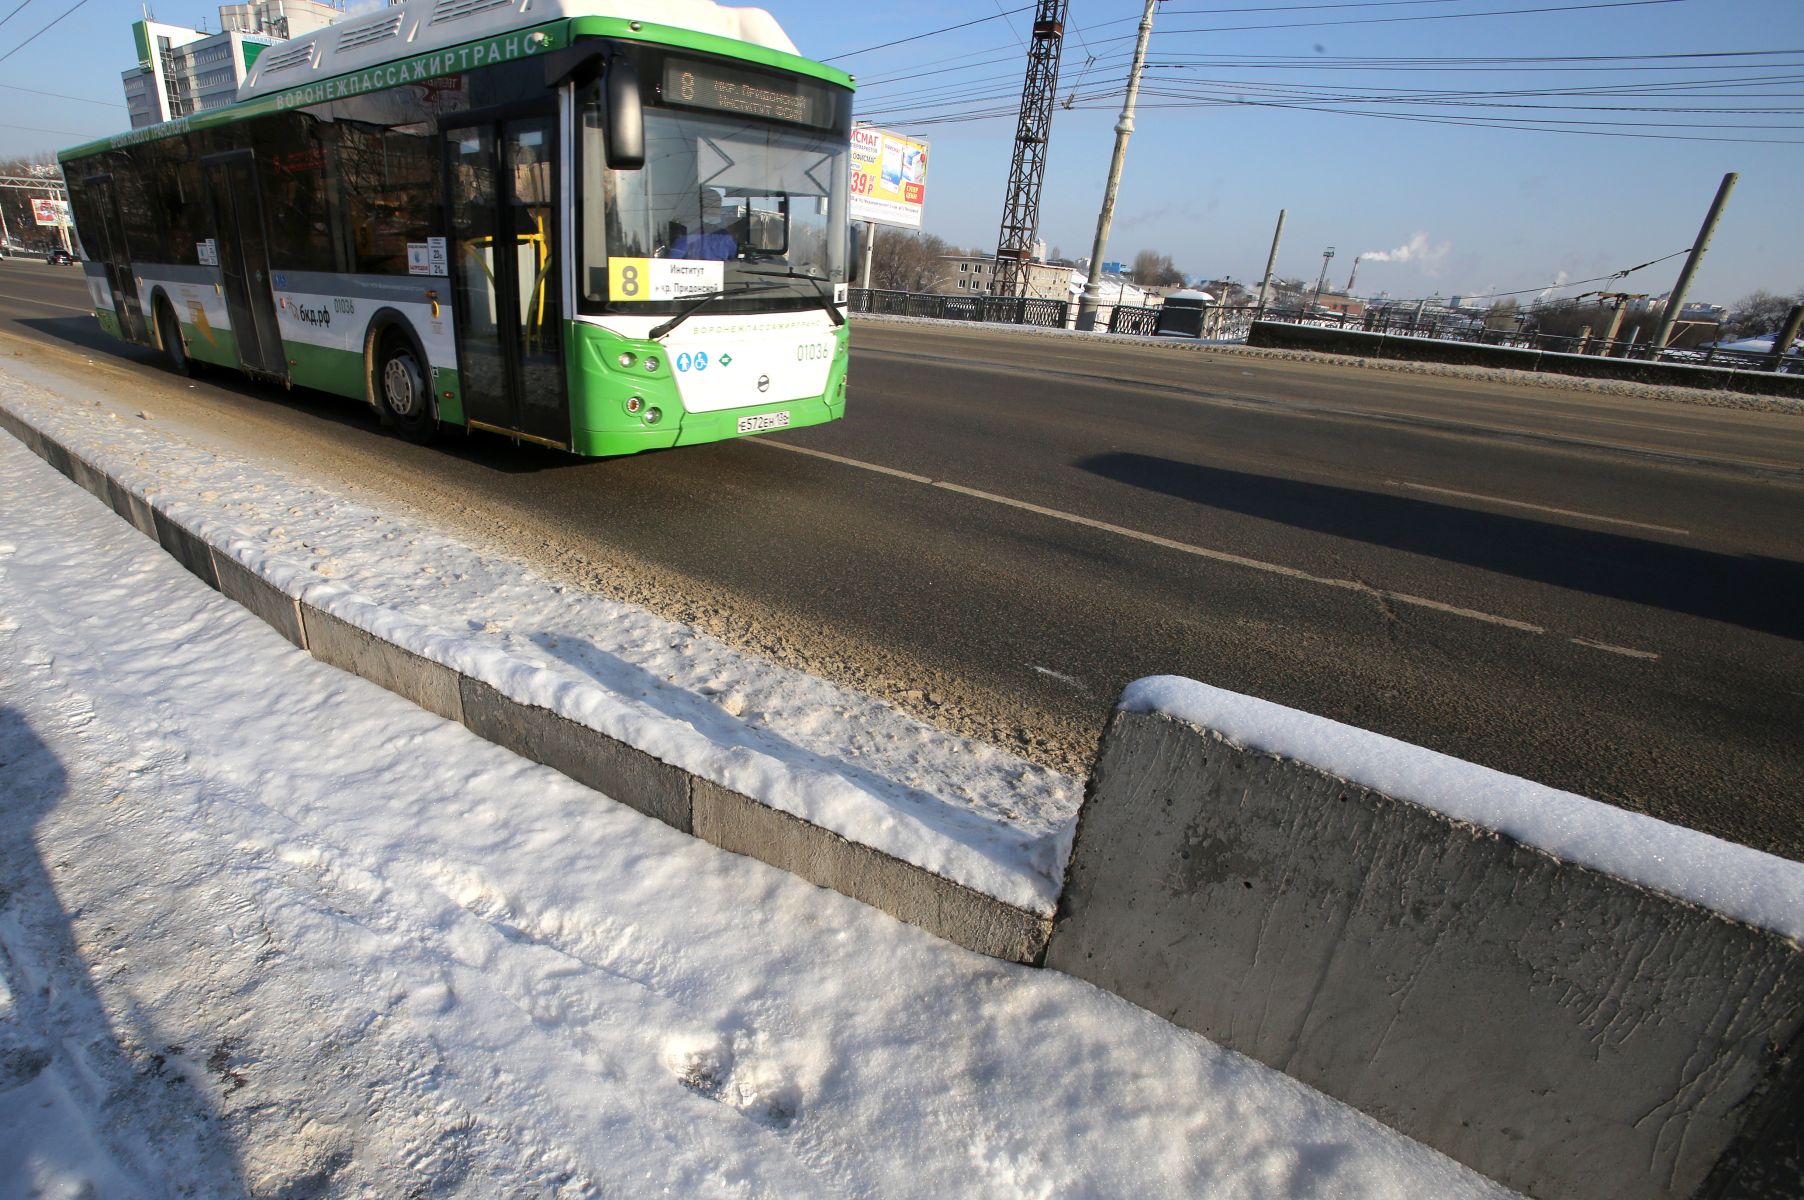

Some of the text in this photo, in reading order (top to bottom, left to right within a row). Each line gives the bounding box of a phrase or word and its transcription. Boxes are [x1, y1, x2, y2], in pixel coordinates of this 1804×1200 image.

[277, 33, 538, 110] ВОРОНЕЖПАССАЖИРТРАНС
[681, 71, 695, 101] 8
[670, 264, 705, 278] Институт
[622, 265, 639, 297] 8
[674, 282, 719, 295] Придонской
[299, 303, 331, 329] бкд.рф
[334, 298, 355, 315] 01036
[693, 319, 821, 335] ВОРОНЕЖПАССАЖИРТРАНС
[797, 343, 829, 362] 01036
